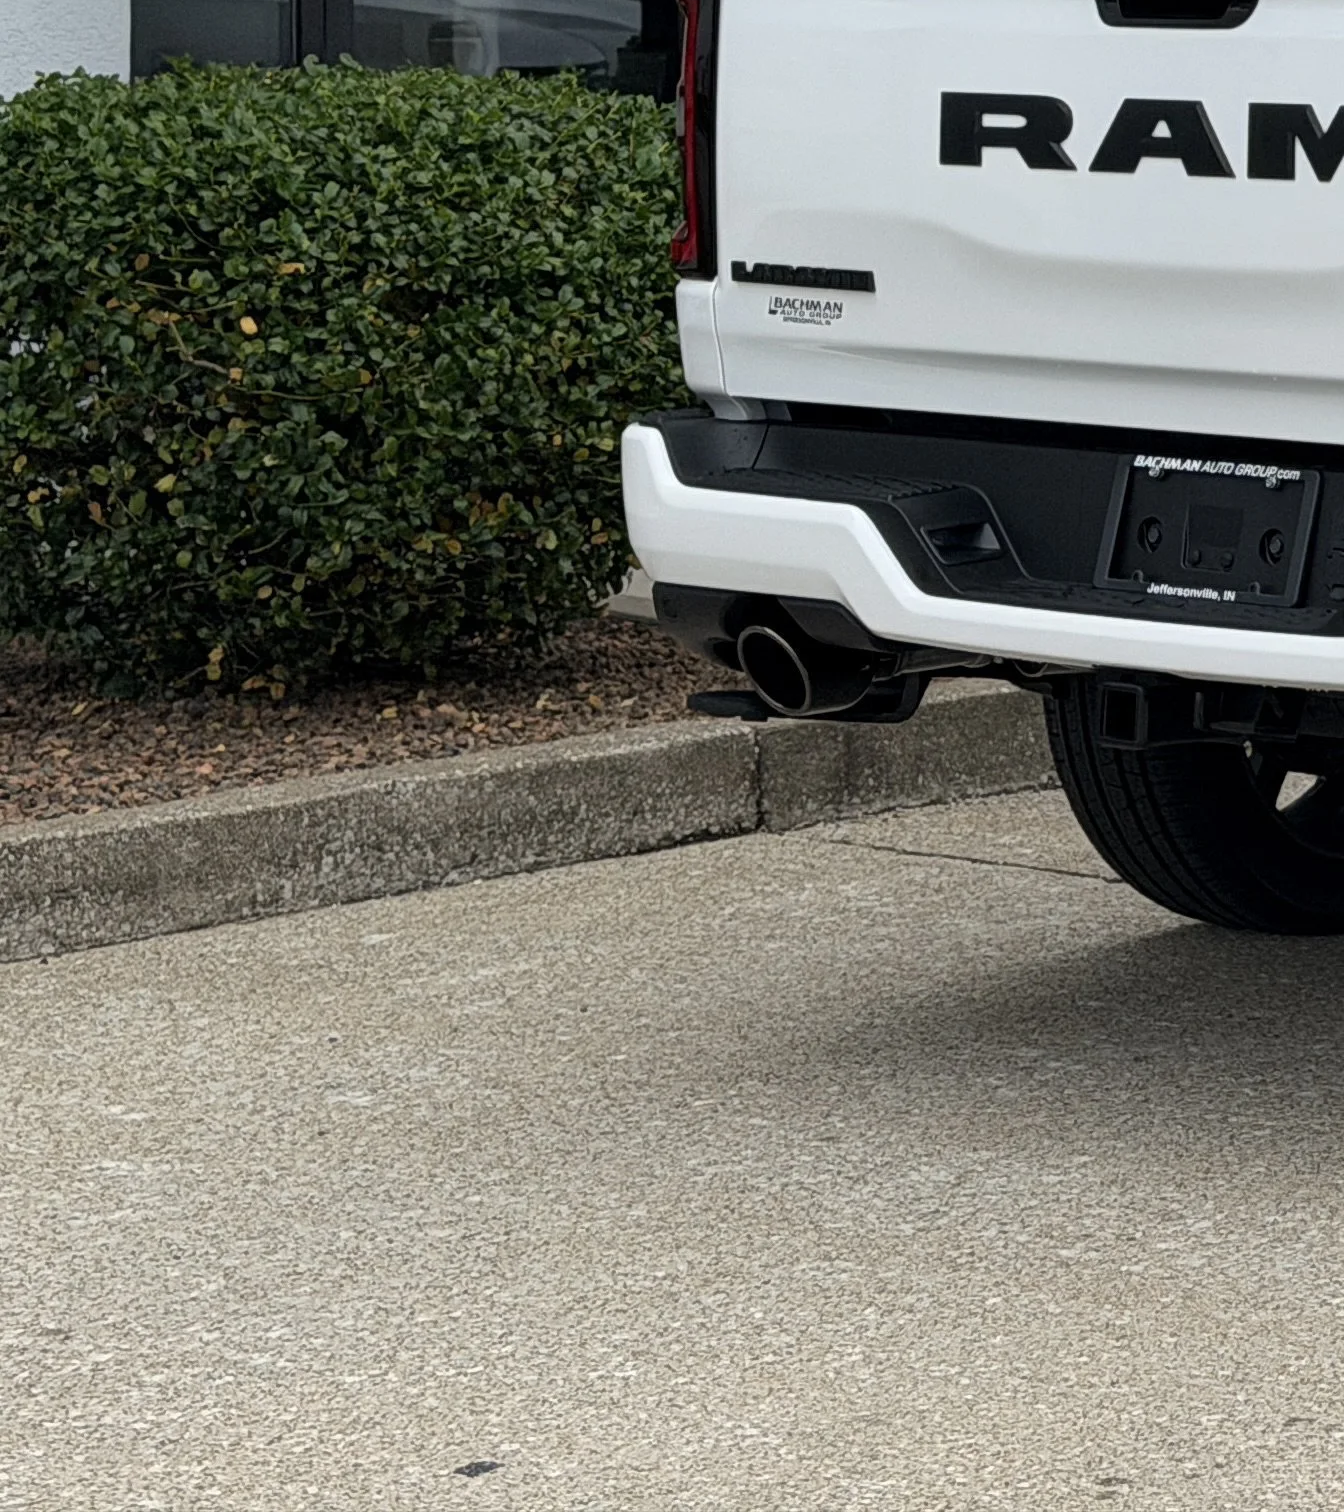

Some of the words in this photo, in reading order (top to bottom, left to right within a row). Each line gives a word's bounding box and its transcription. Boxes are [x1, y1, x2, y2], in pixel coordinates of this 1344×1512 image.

[774, 297, 843, 313] BACHMAN
[780, 309, 805, 317] AUTO
[809, 311, 842, 319] GROUP
[1134, 455, 1201, 472] BACHMAN
[1201, 460, 1235, 475] AUTO
[1147, 582, 1221, 601] Jeffersonville,
[1223, 590, 1236, 601] IN
